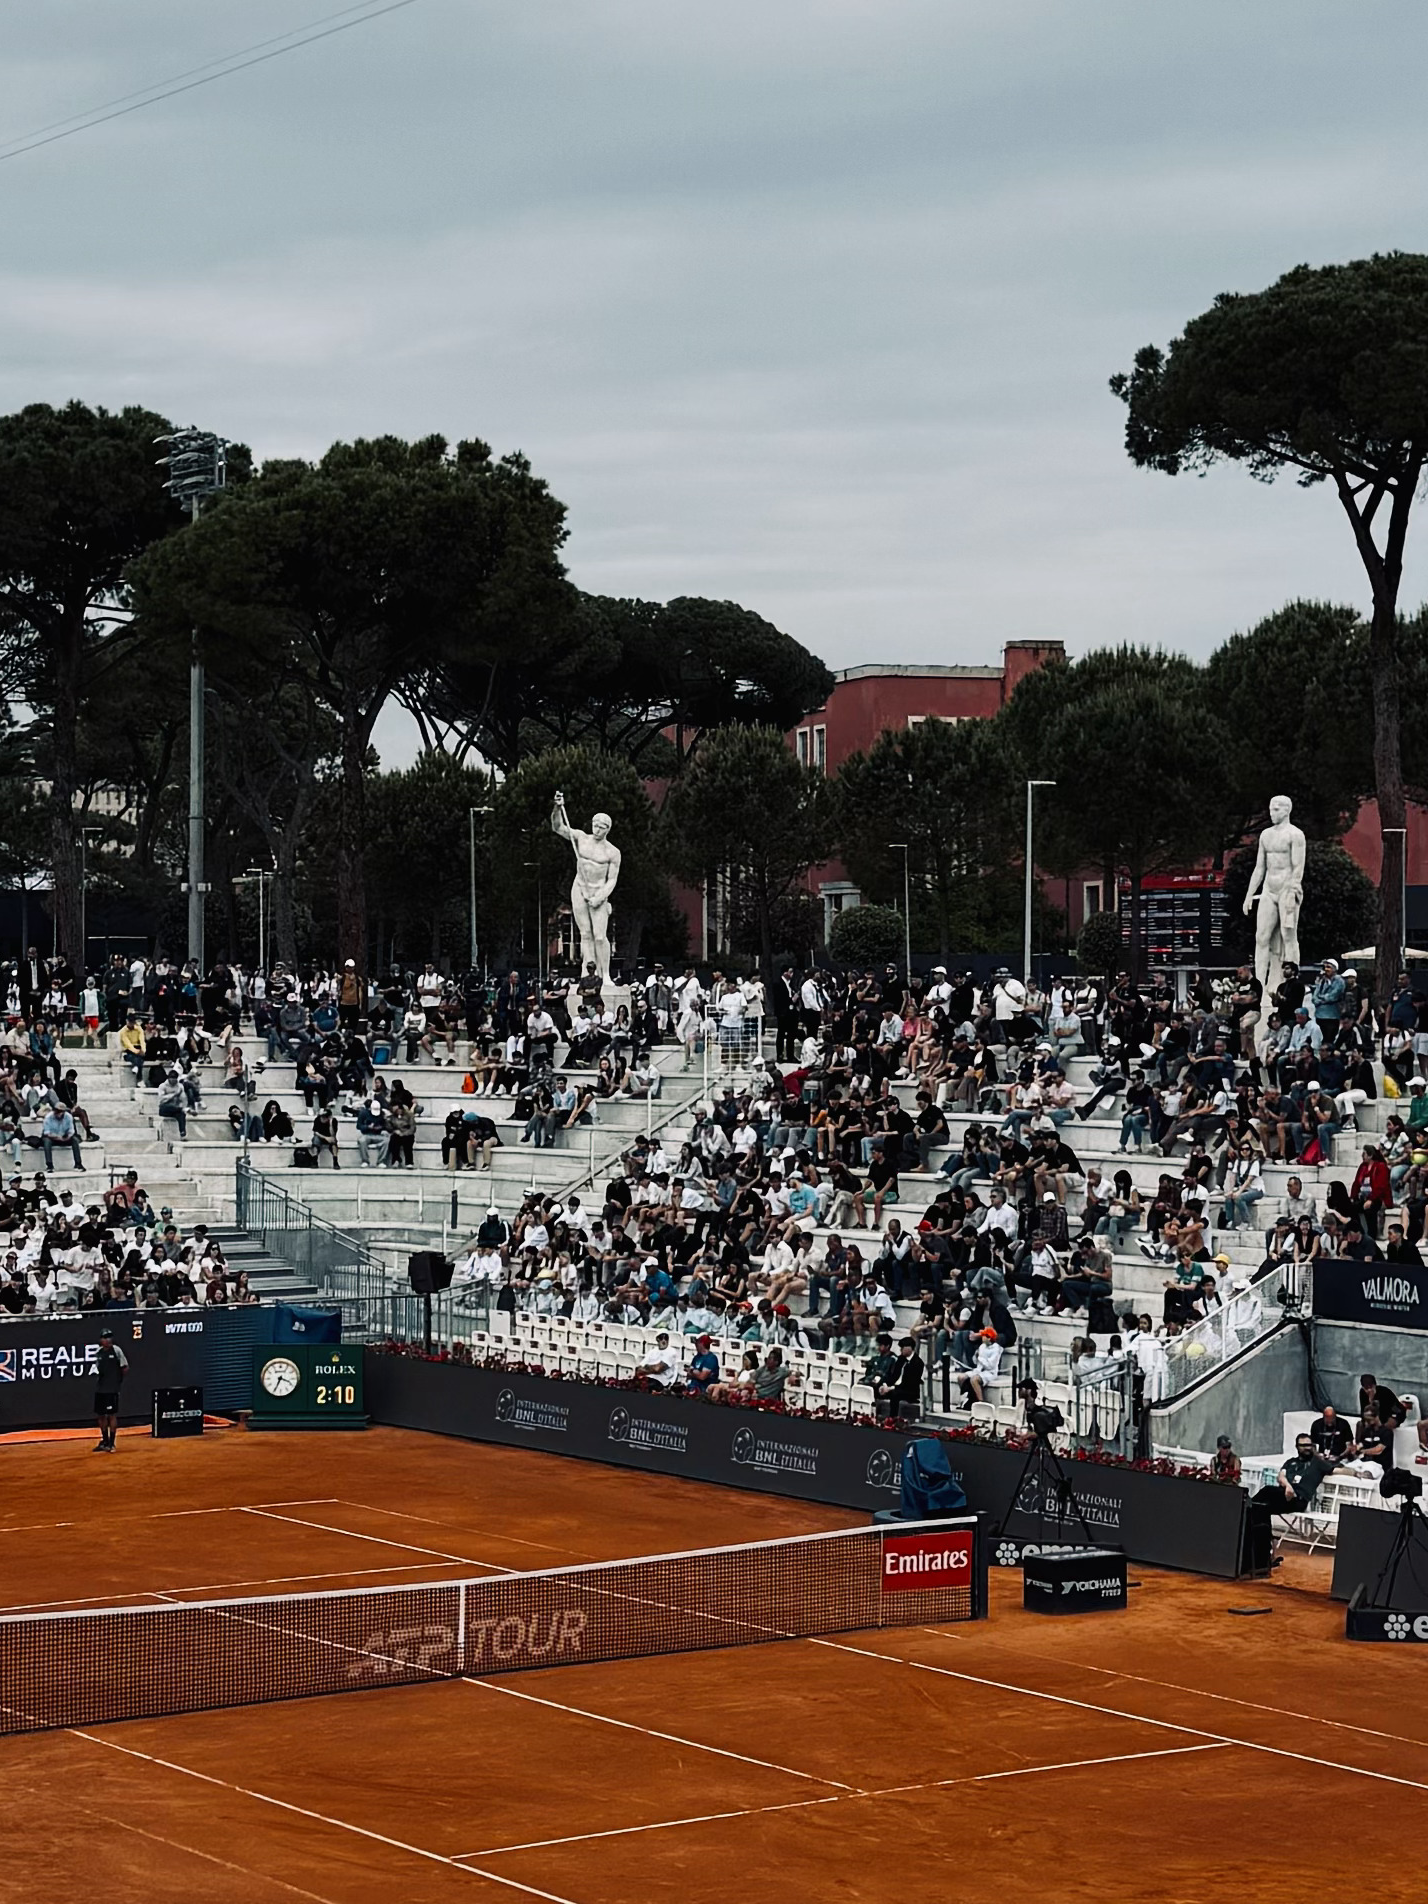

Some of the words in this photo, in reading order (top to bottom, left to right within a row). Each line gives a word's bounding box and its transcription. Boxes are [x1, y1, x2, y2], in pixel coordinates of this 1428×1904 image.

[1362, 1276, 1420, 1304] VALMORA
[22, 1344, 101, 1366] REALE
[22, 1363, 100, 1379] MUTUA
[315, 1365, 356, 1375] ROLEX
[316, 1385, 354, 1404] 2:10
[755, 1449, 780, 1465] BNL
[885, 1549, 968, 1575] Emirates
[1061, 1577, 1121, 1595] YOKOHAMA
[340, 1625, 455, 1678] ATP
[470, 1609, 588, 1663] TOUR
